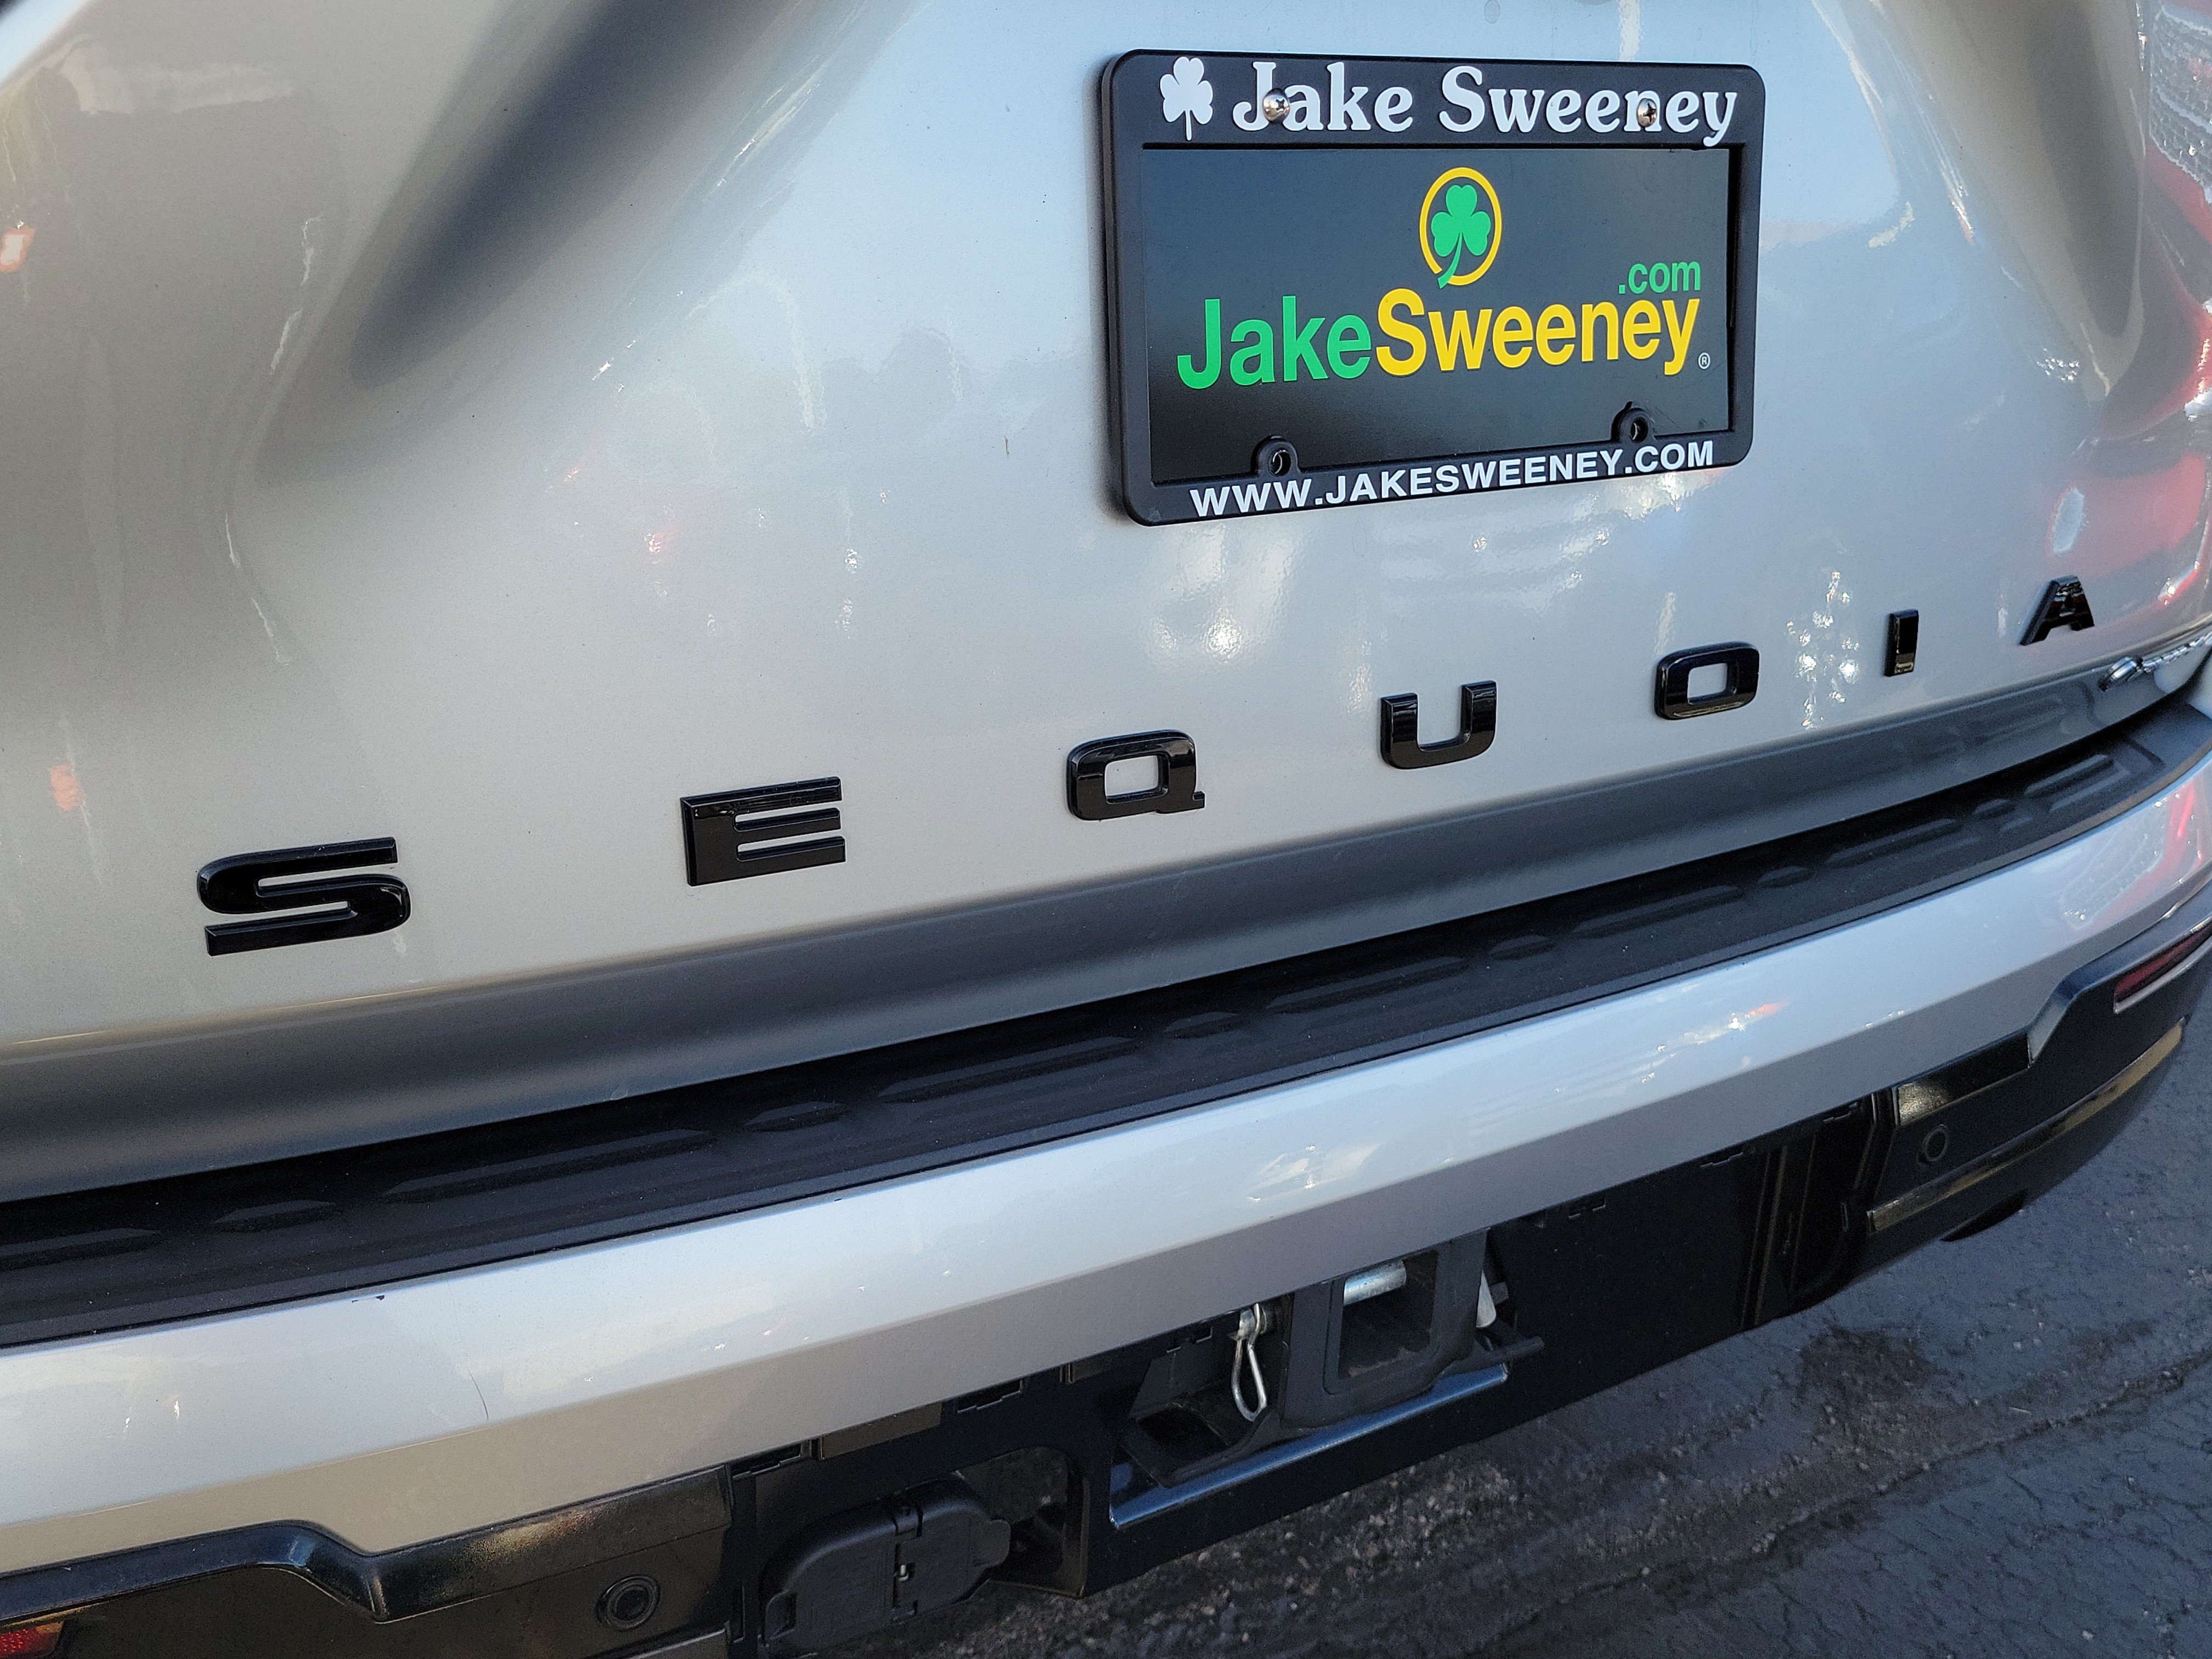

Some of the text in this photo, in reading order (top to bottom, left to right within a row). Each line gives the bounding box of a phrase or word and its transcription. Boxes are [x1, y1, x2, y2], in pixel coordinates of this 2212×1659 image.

[1233, 61, 1738, 147] Jake Sweeney
[1618, 260, 1701, 295] .com
[1189, 440, 1714, 518] WWW.JAKESWEENEY.COM
[198, 575, 2095, 956] SEQUOIA
